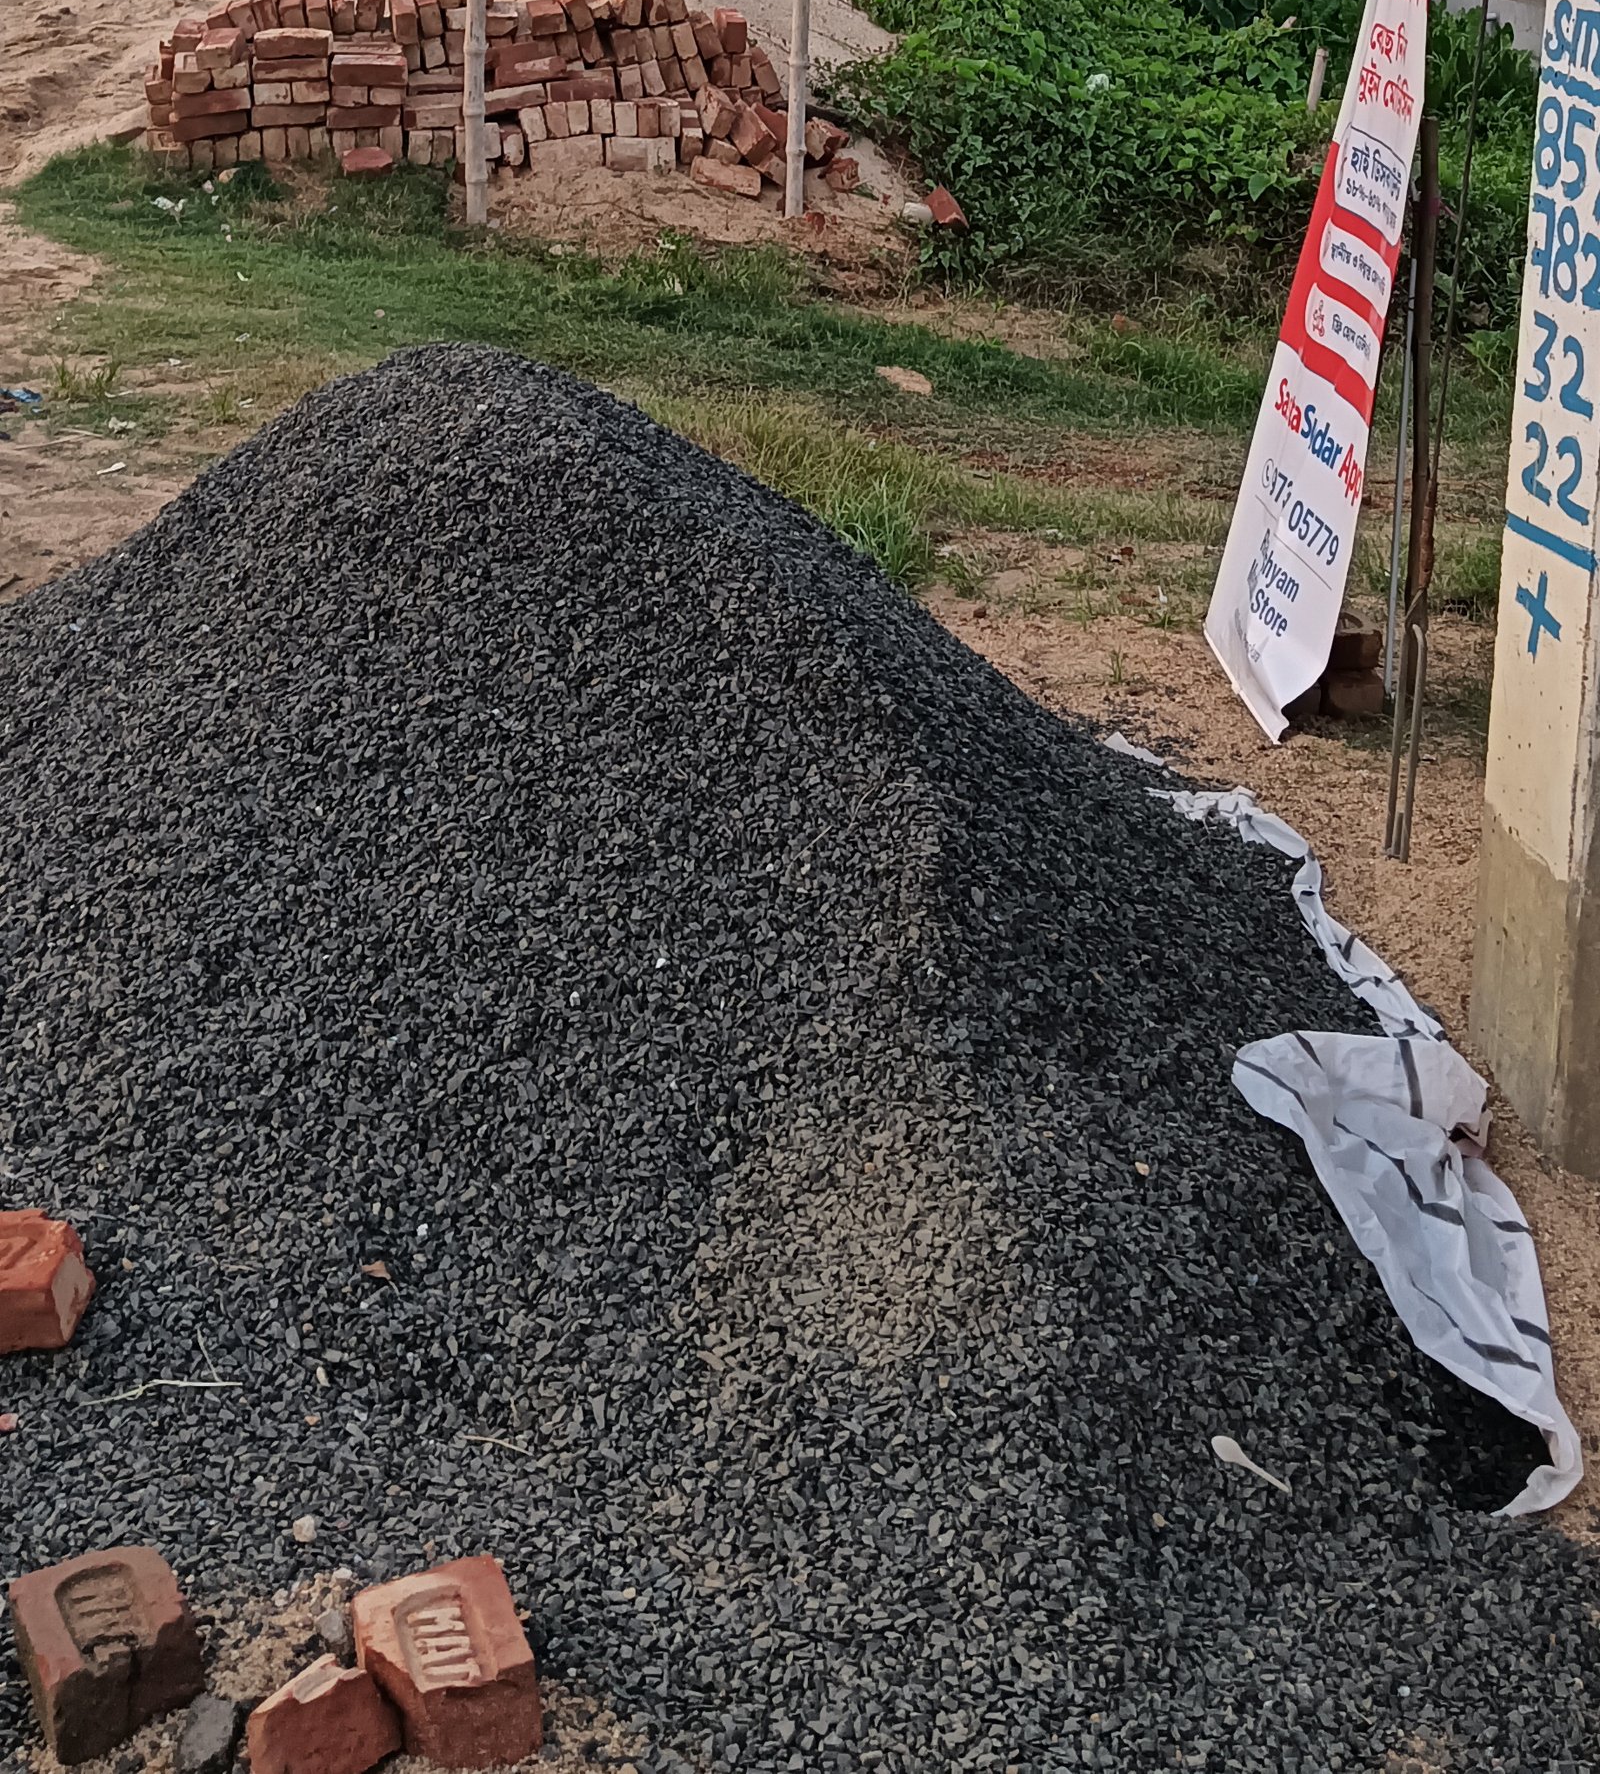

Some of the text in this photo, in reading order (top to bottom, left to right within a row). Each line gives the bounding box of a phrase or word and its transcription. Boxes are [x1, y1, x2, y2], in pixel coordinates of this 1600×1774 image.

[1534, 95, 1600, 224] 85
[1523, 310, 1594, 421] 32
[1521, 421, 1590, 530] 22
[1288, 500, 1339, 566] 05779
[1250, 588, 1288, 637] Store
